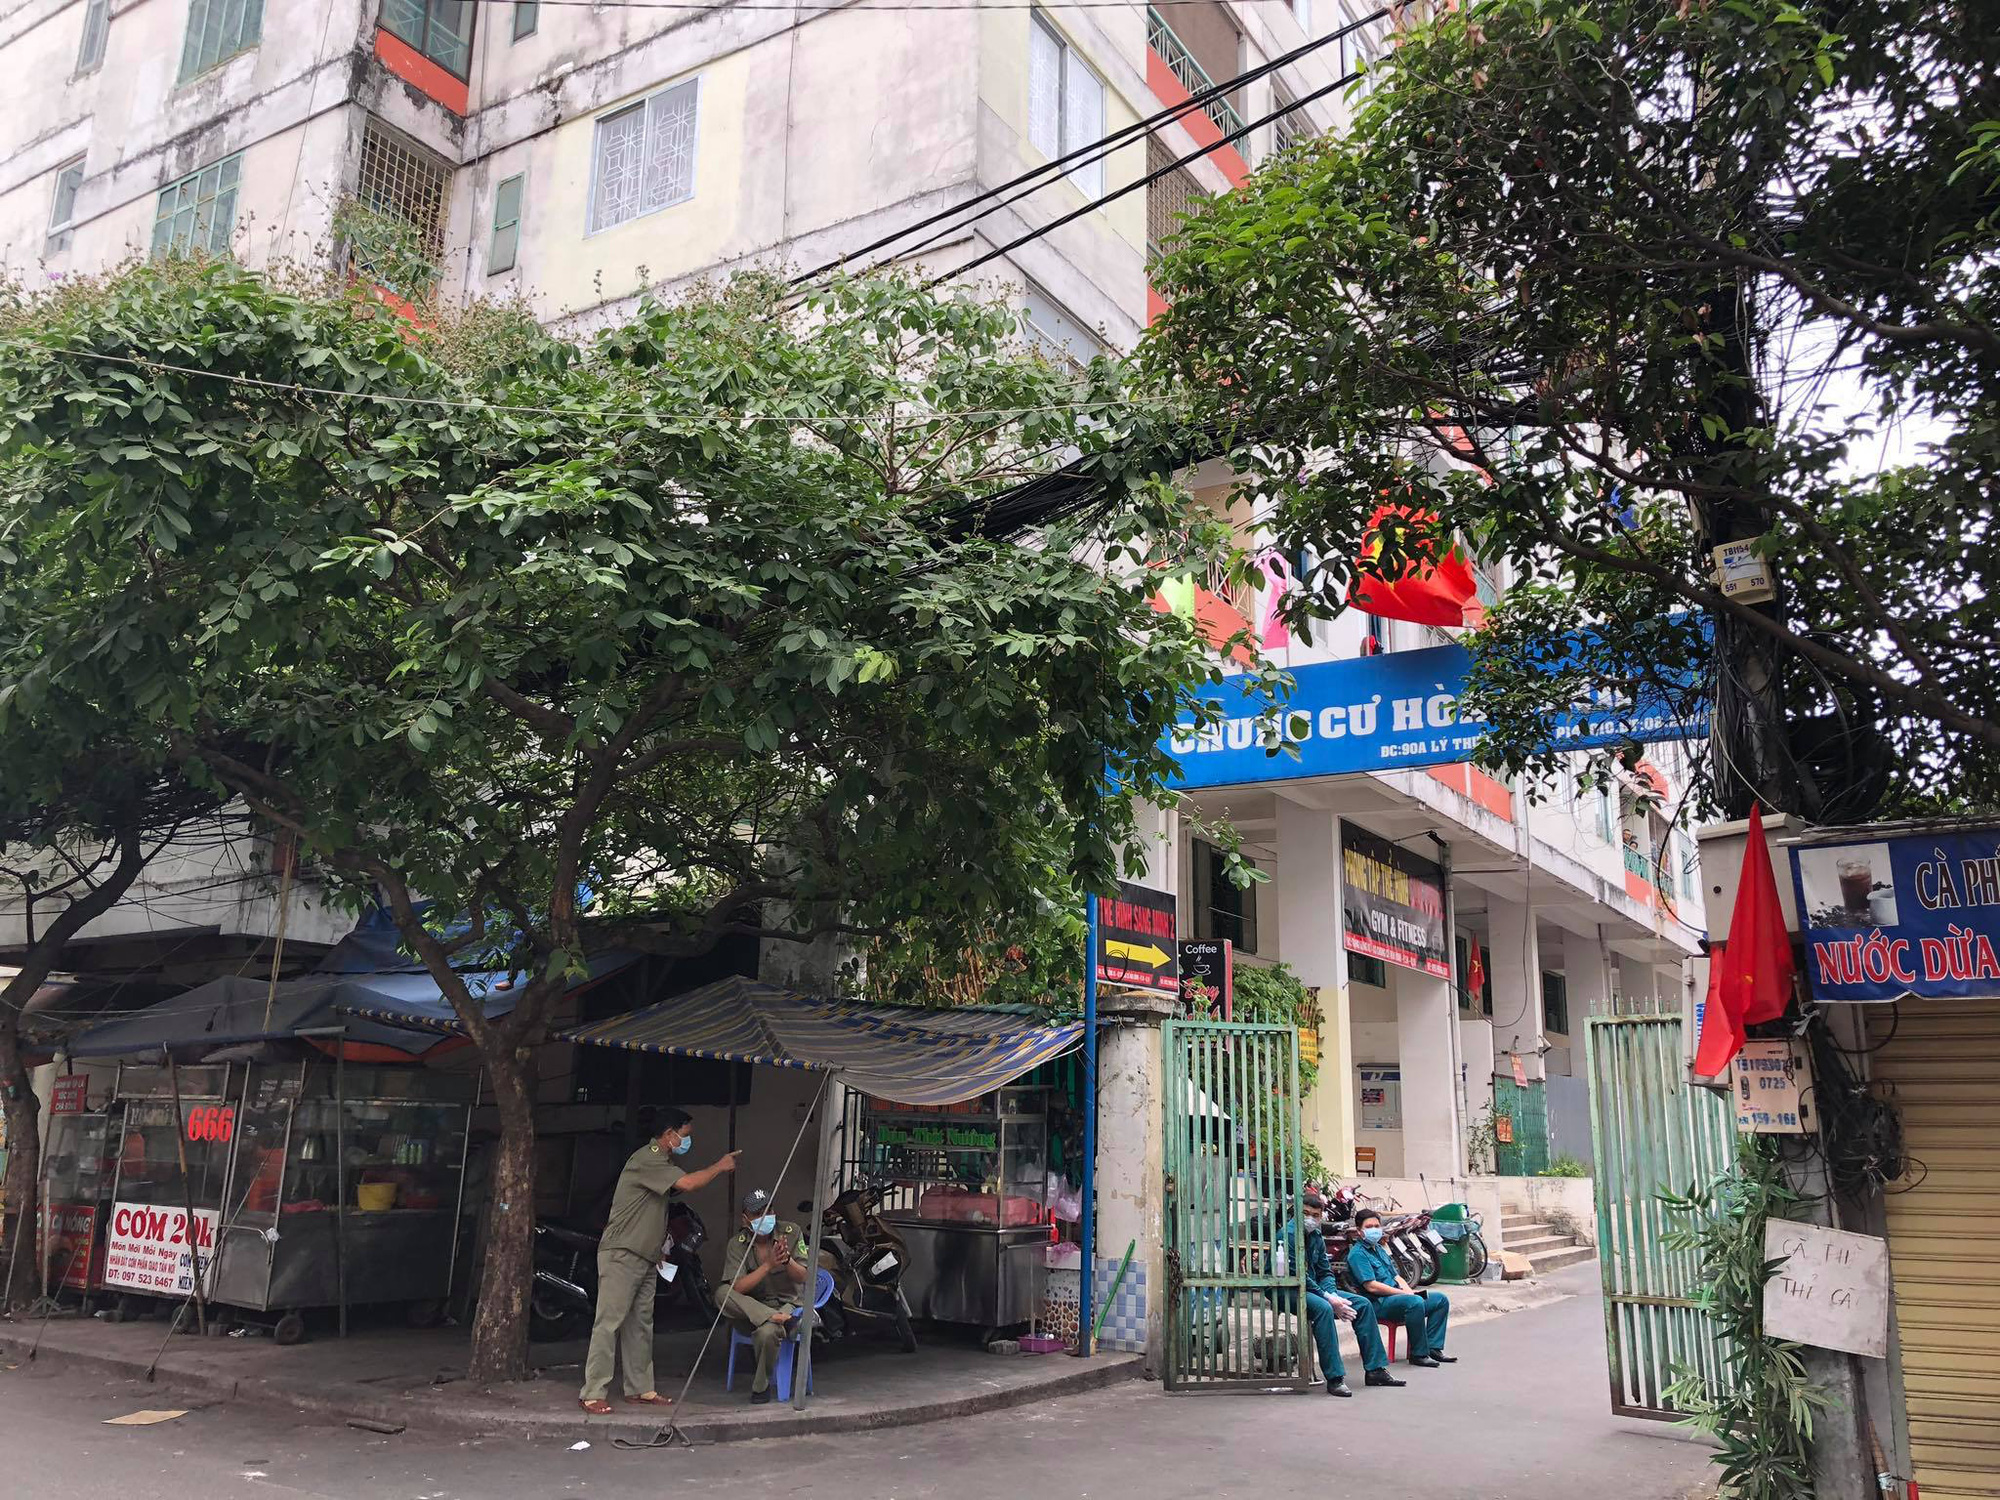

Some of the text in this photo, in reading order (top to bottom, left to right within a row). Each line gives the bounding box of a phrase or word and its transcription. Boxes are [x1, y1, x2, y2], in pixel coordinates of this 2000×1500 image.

[1723, 544, 1752, 556] TB1154
[1751, 578, 1765, 587] 570
[1319, 694, 1382, 740] CƯ
[1430, 735, 1449, 754] LÝ
[1915, 844, 2000, 910] CÀ PH
[1371, 909, 1427, 949] GYM & FITNESS
[1185, 943, 1218, 955] Coffee
[1814, 923, 2000, 985] NƯỚC DỪA
[1759, 1076, 1786, 1090] 0725
[188, 1106, 233, 1141] 666
[114, 1205, 168, 1242] CƠM
[121, 1271, 136, 1282] 097
[138, 1273, 152, 1285] 523
